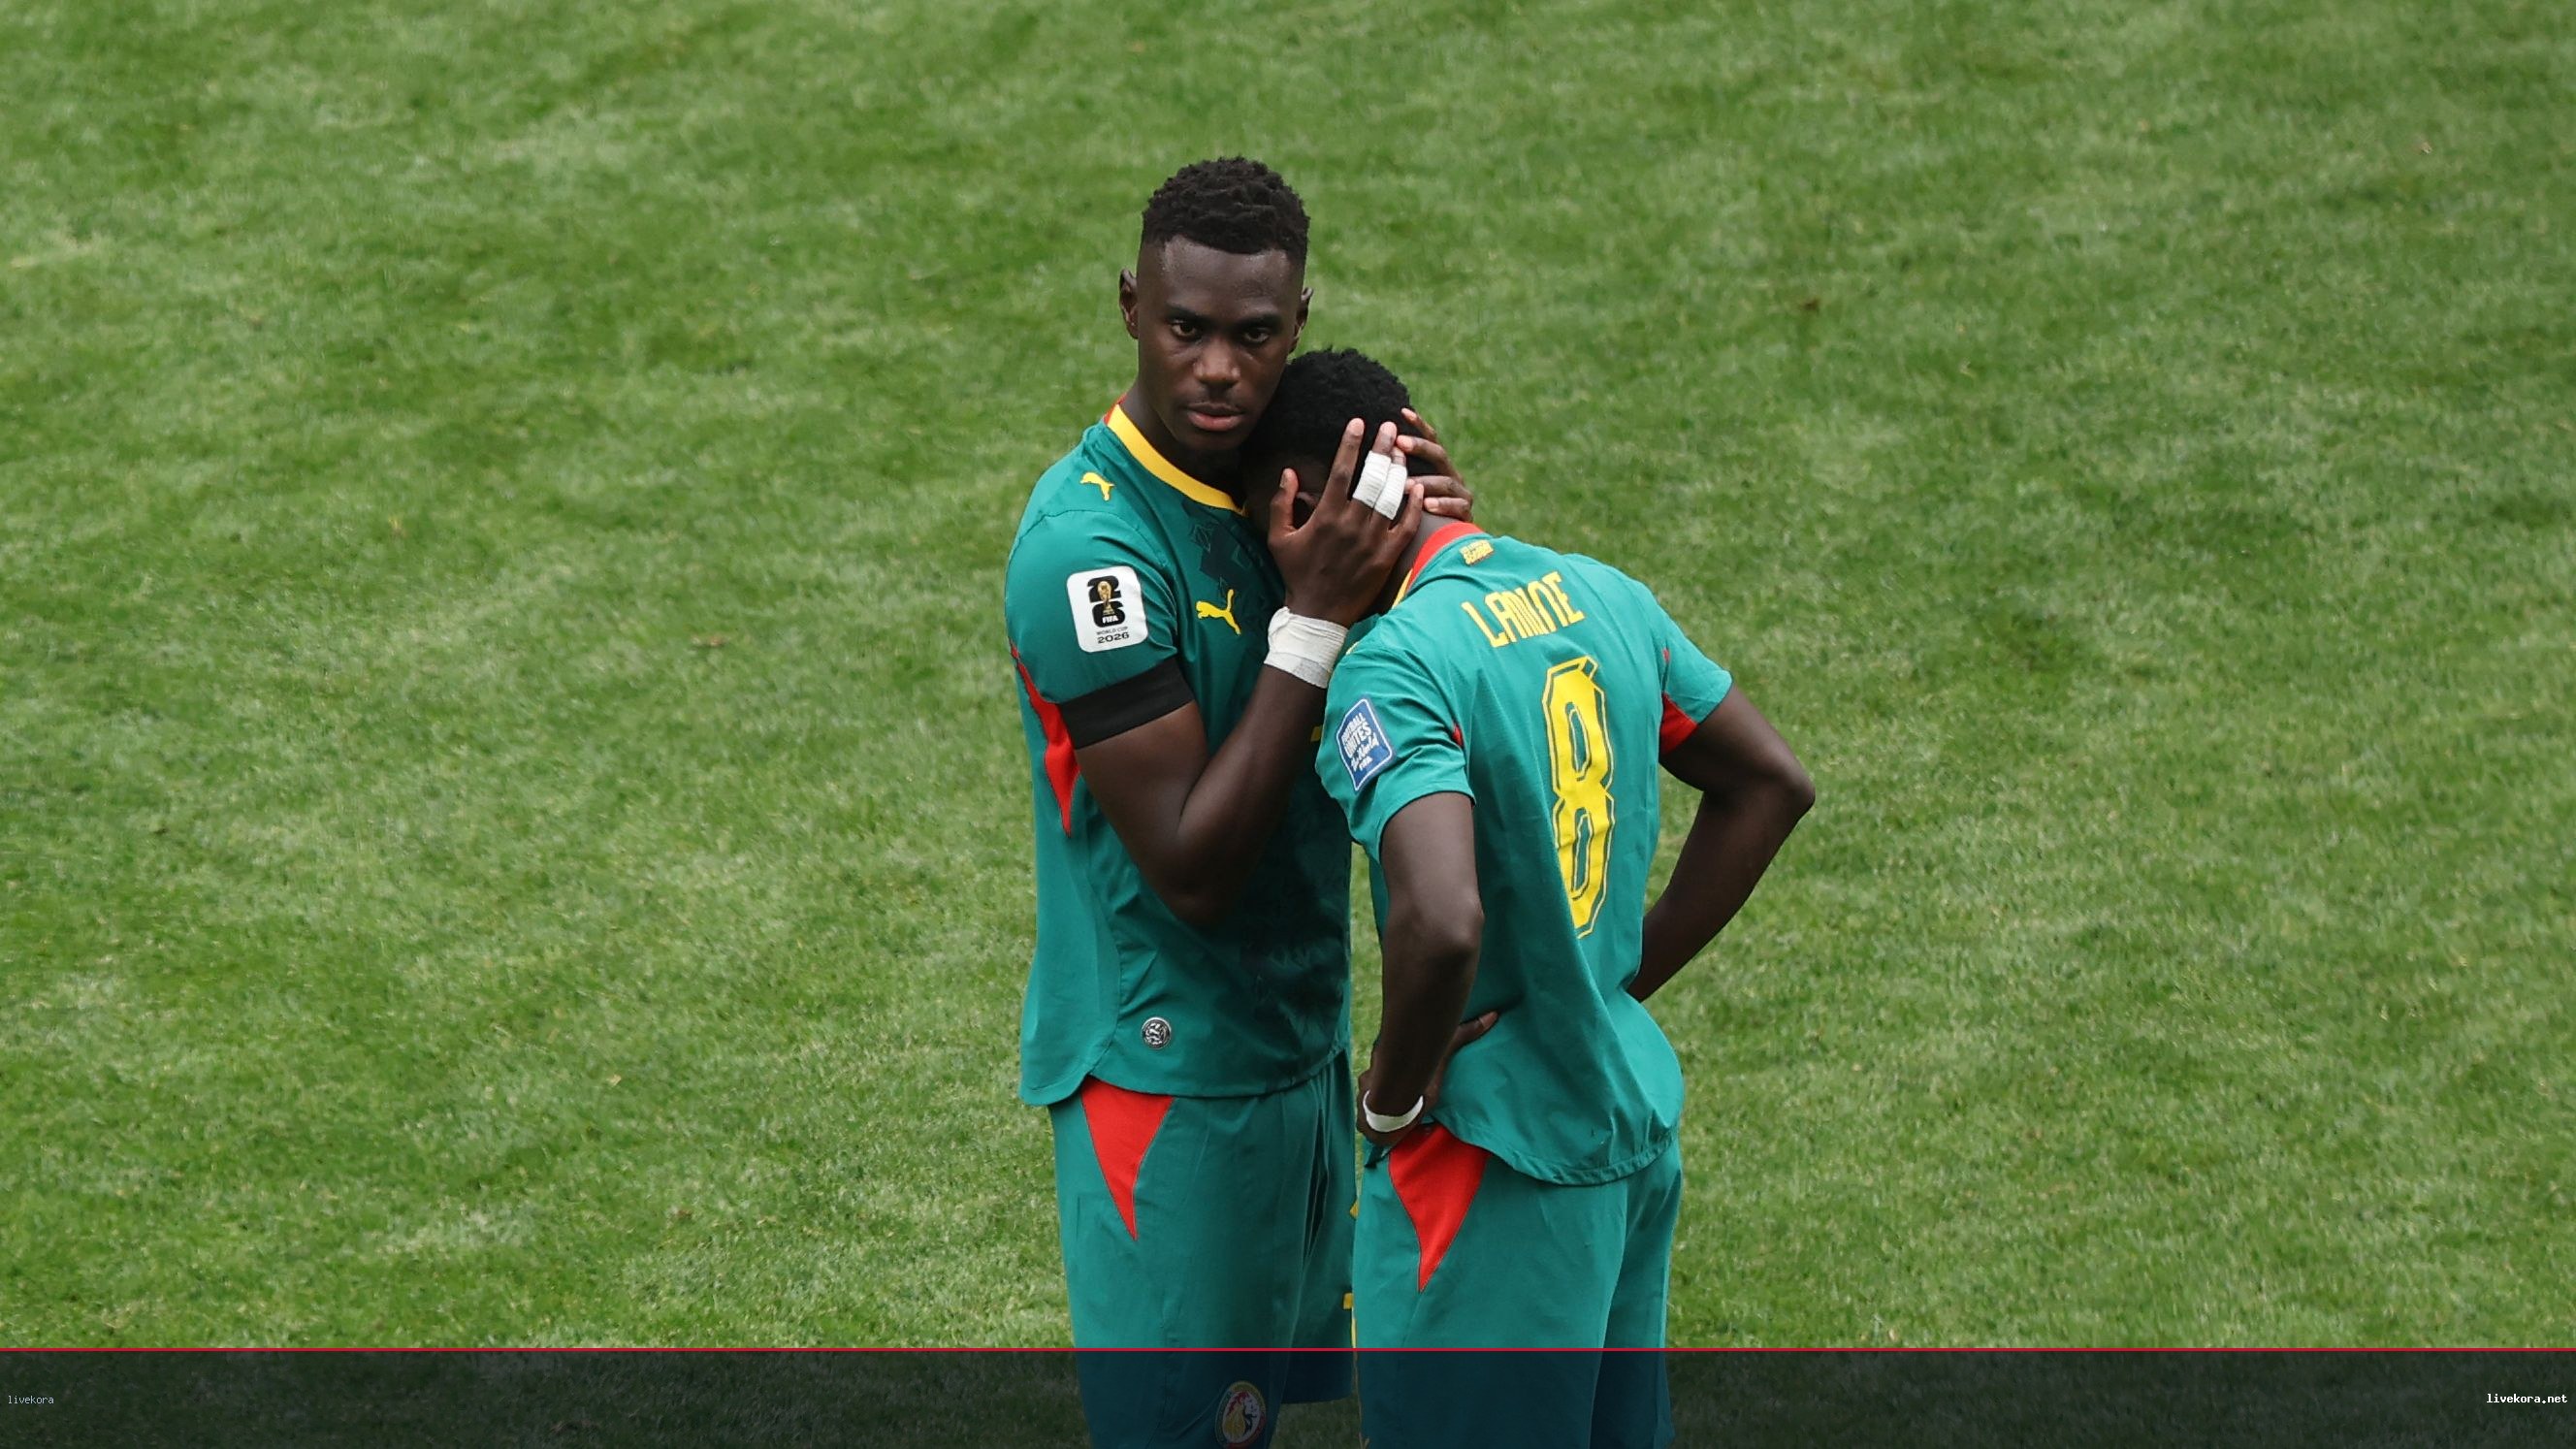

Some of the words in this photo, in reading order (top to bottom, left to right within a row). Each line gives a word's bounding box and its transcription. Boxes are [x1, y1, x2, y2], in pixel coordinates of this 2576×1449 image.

[1102, 615, 1119, 624] FIFA
[1097, 631, 1130, 644] 2026
[1542, 655, 1615, 940] 8
